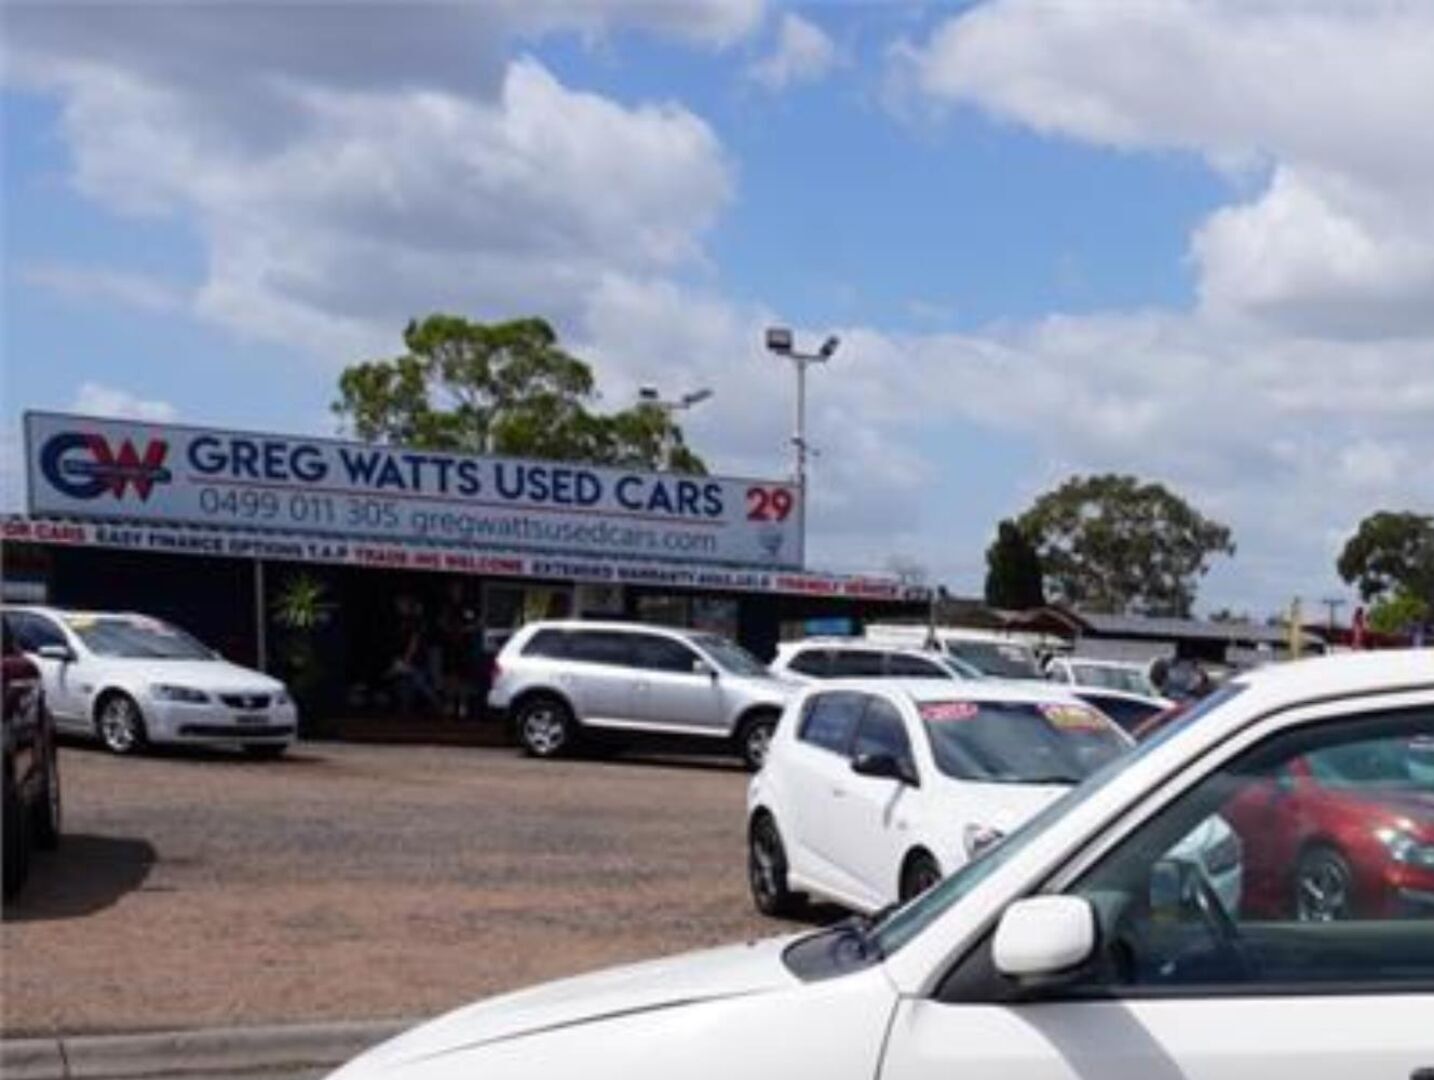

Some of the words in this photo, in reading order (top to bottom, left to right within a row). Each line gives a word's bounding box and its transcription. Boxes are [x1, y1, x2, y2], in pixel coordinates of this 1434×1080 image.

[188, 436, 327, 482] GREG
[338, 448, 480, 495] WATTS
[494, 464, 602, 506] USED
[614, 475, 724, 518] CARS
[746, 486, 793, 522] 29
[200, 487, 278, 519] 0499
[289, 496, 335, 523] 011
[348, 500, 399, 529] 305
[411, 511, 716, 551] gregwattsusedcars.com
